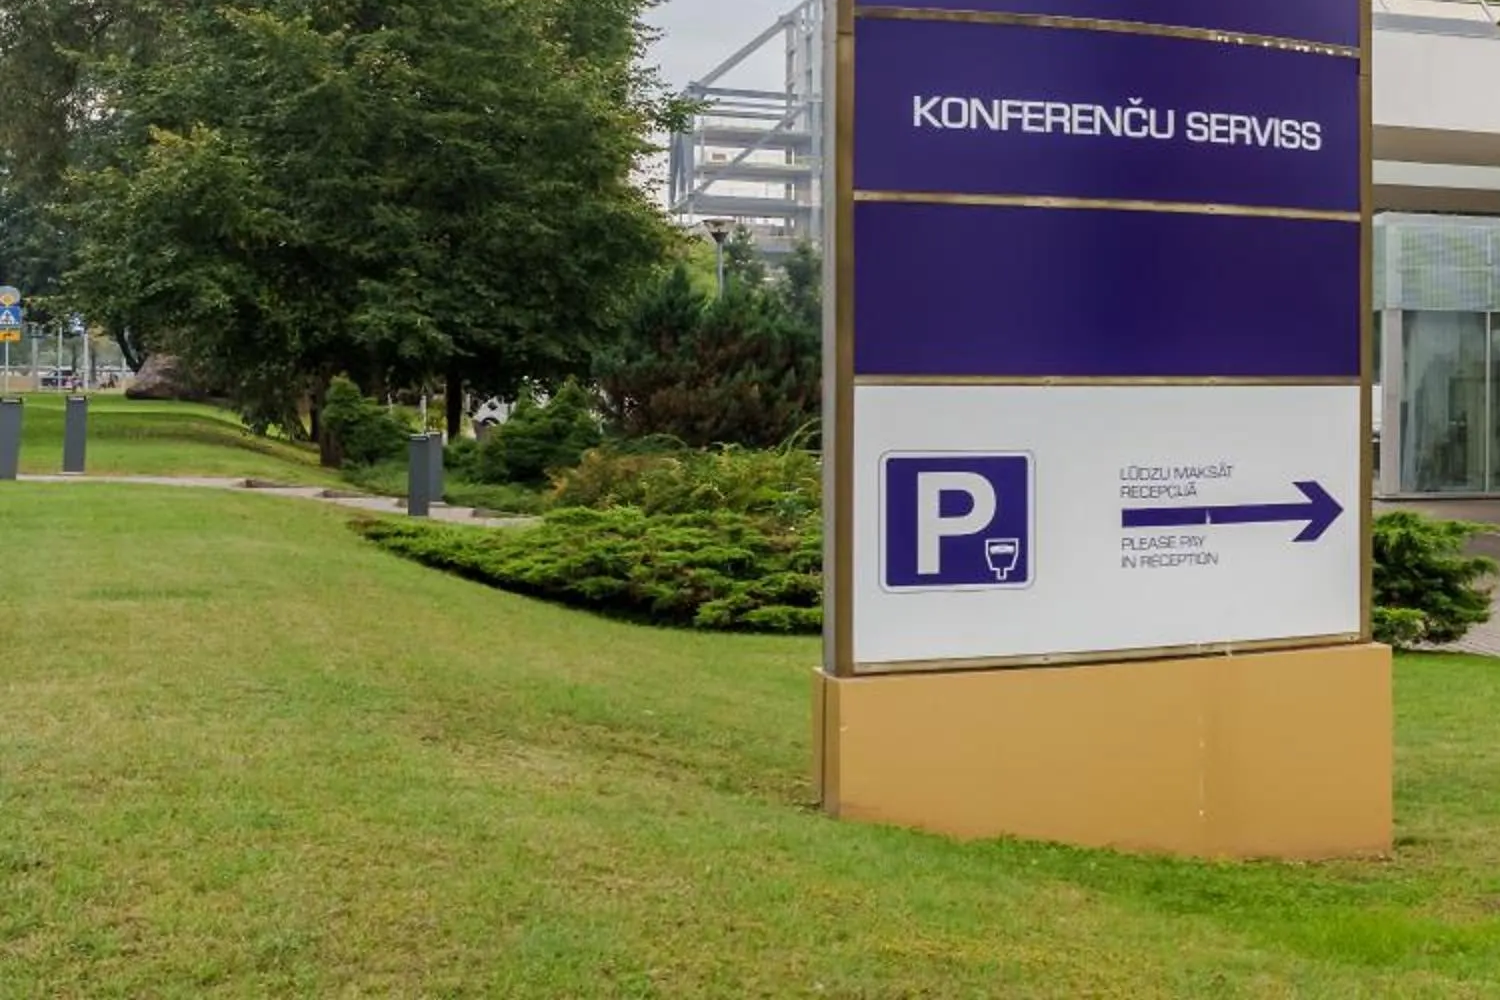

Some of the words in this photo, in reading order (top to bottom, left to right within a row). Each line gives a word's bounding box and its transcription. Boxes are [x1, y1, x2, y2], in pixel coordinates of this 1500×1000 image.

[912, 95, 1175, 141] KONFERENČU
[1185, 110, 1322, 152] SERVISS
[917, 471, 997, 575] P
[1121, 535, 1177, 551] PLEASE
[1179, 535, 1206, 548] PAY
[1121, 556, 1137, 569] IN
[1140, 552, 1218, 567] RECEPTION
